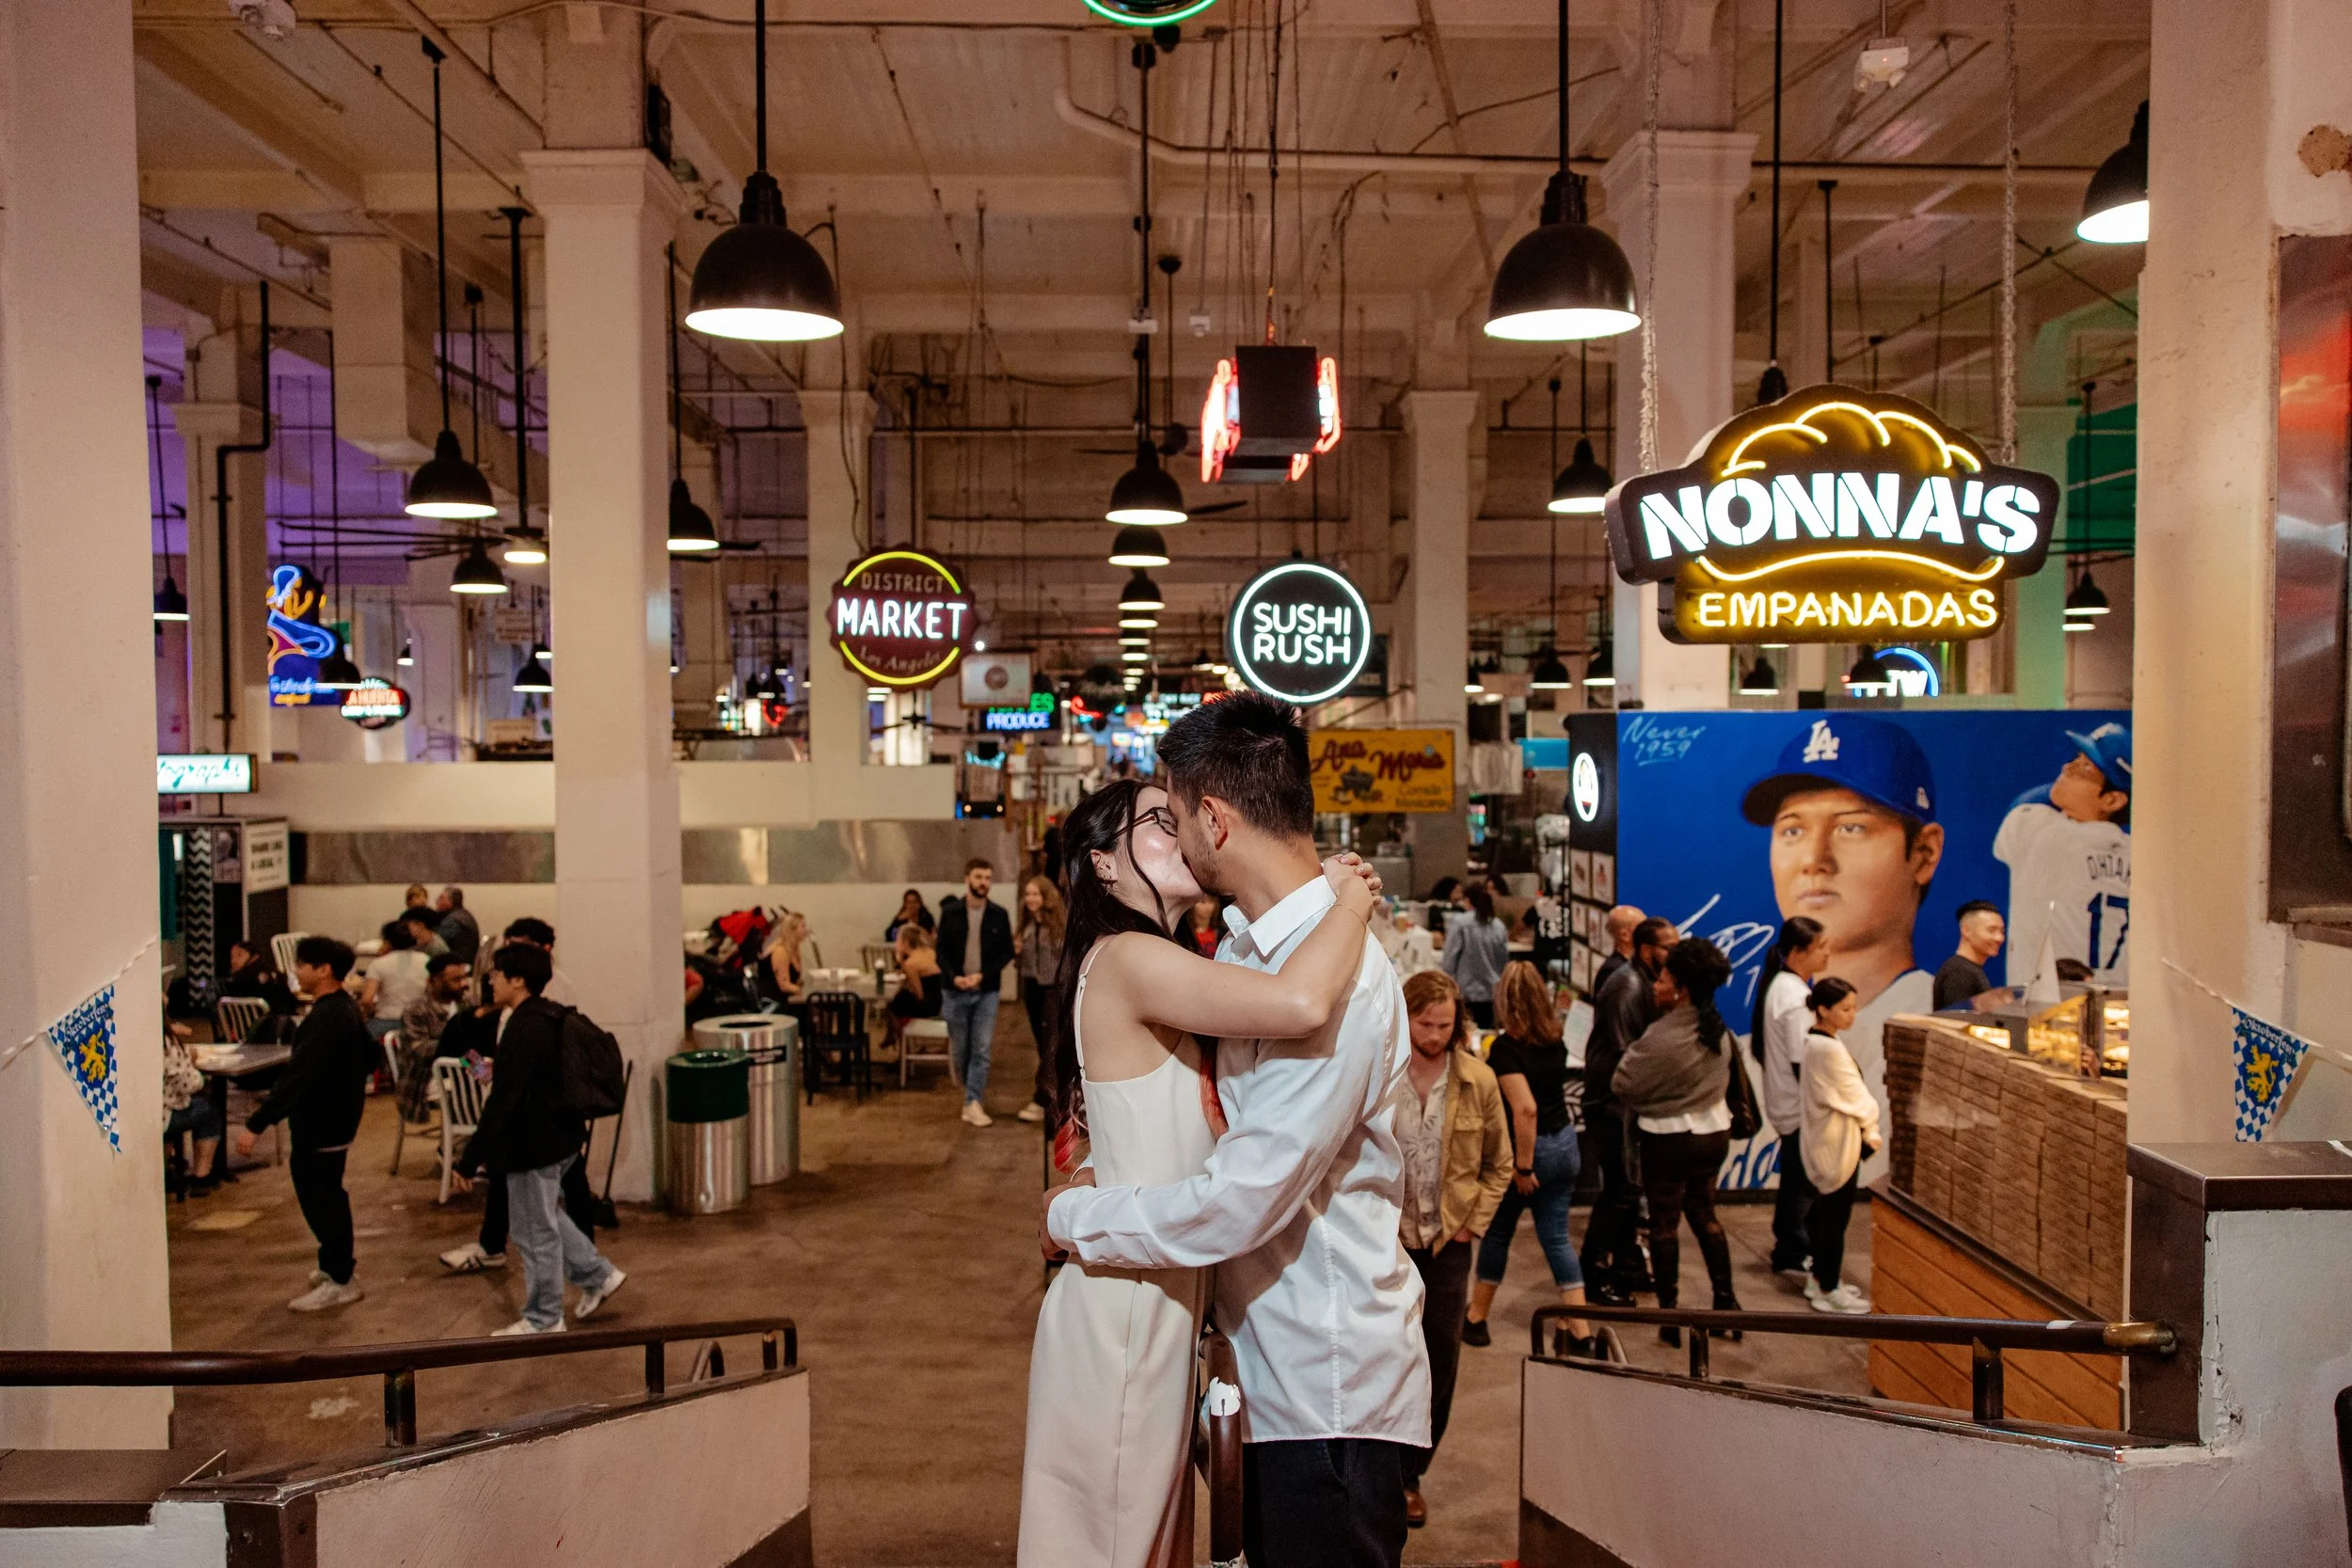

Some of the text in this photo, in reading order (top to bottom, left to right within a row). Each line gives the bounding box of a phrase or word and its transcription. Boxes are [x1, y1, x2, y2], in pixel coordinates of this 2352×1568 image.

[1640, 472, 2042, 561] NONNA'S
[861, 572, 945, 594] DISTRICT
[836, 597, 968, 641] MARKET
[1252, 602, 1352, 636] SUSHI
[1698, 588, 1997, 628] EMPANADAS
[1252, 632, 1352, 666] RUSH
[986, 712, 1051, 731] PRODUCE
[1622, 715, 1707, 743] Never
[1634, 739, 1692, 762] 1959
[2087, 855, 2131, 886] OHTA
[2086, 892, 2130, 970] 17
